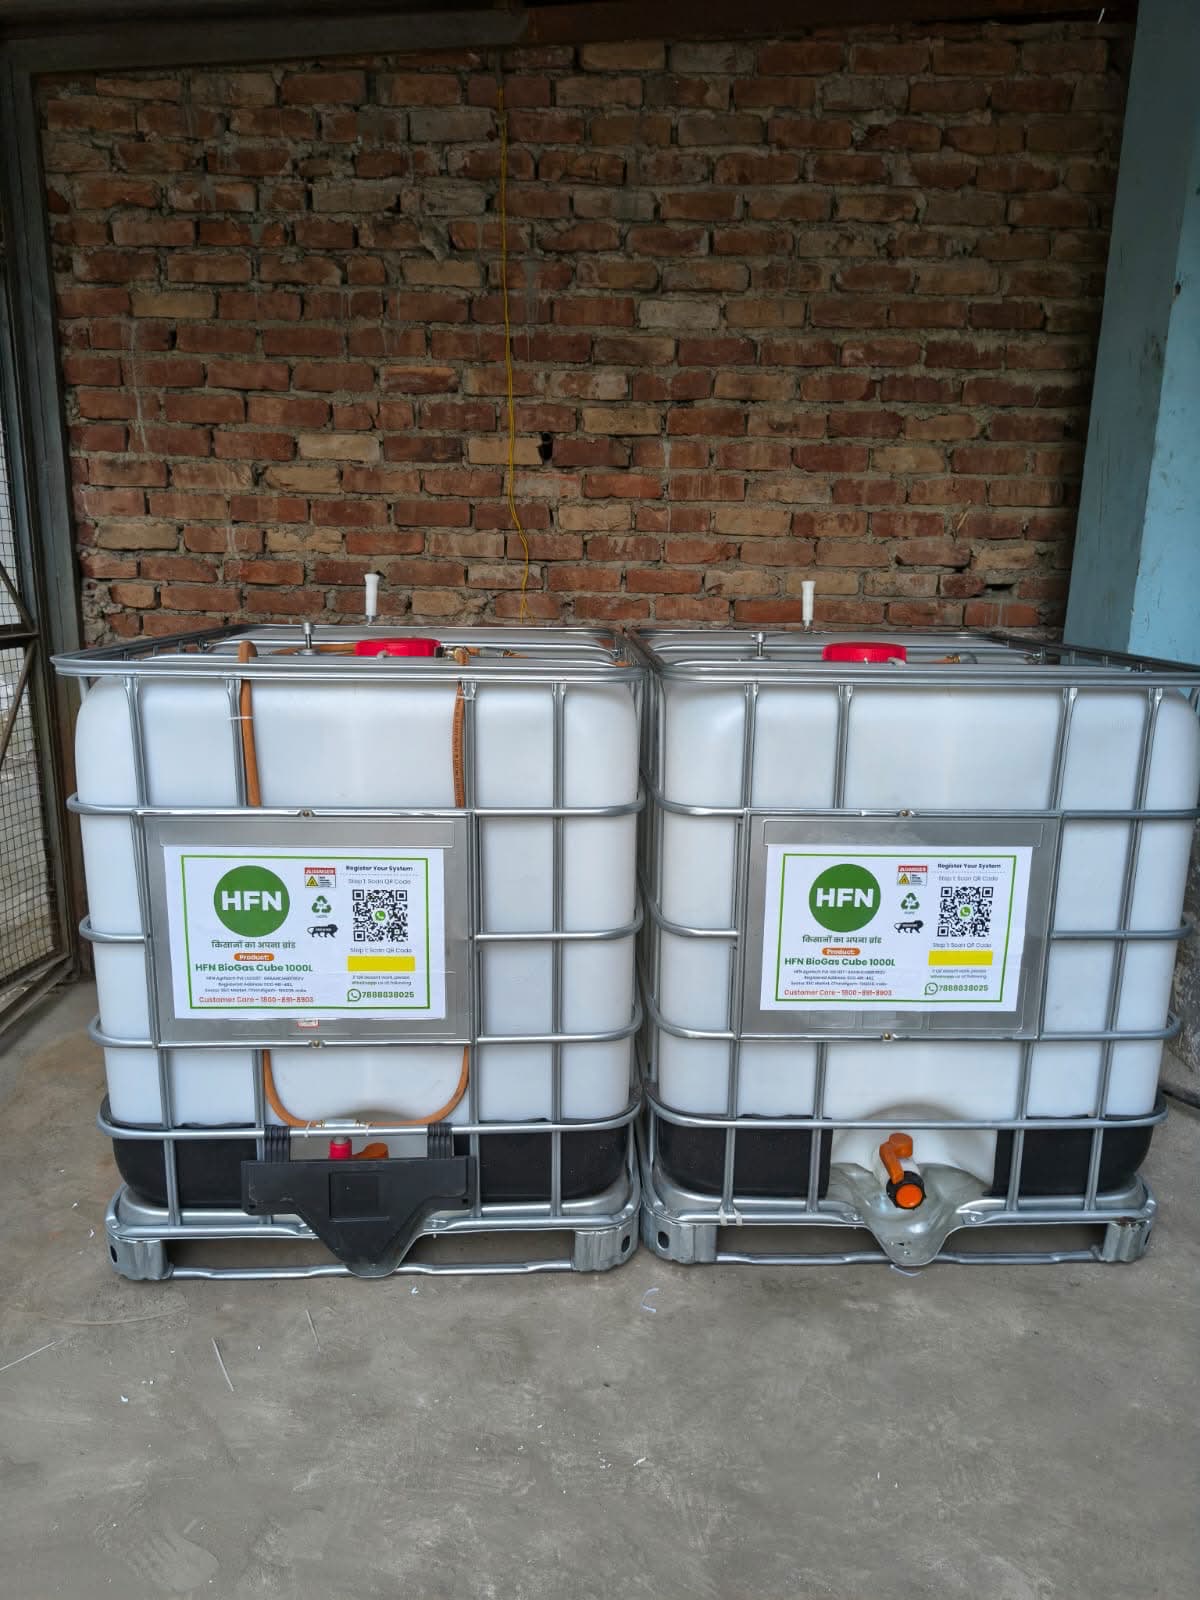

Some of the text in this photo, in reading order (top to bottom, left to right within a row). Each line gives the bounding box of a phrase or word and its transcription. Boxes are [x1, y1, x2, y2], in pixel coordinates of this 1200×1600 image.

[389, 865, 413, 873] System
[221, 890, 282, 911] HFN
[816, 888, 874, 908] HFN
[833, 935, 844, 943] का
[846, 935, 867, 943] अपना
[211, 940, 242, 949] किसानों
[244, 940, 256, 949] का
[258, 940, 280, 949] अपना
[784, 958, 895, 966] HFN BioGas Cube 1000L
[195, 963, 313, 971] HFN BioGas Cube 1000L
